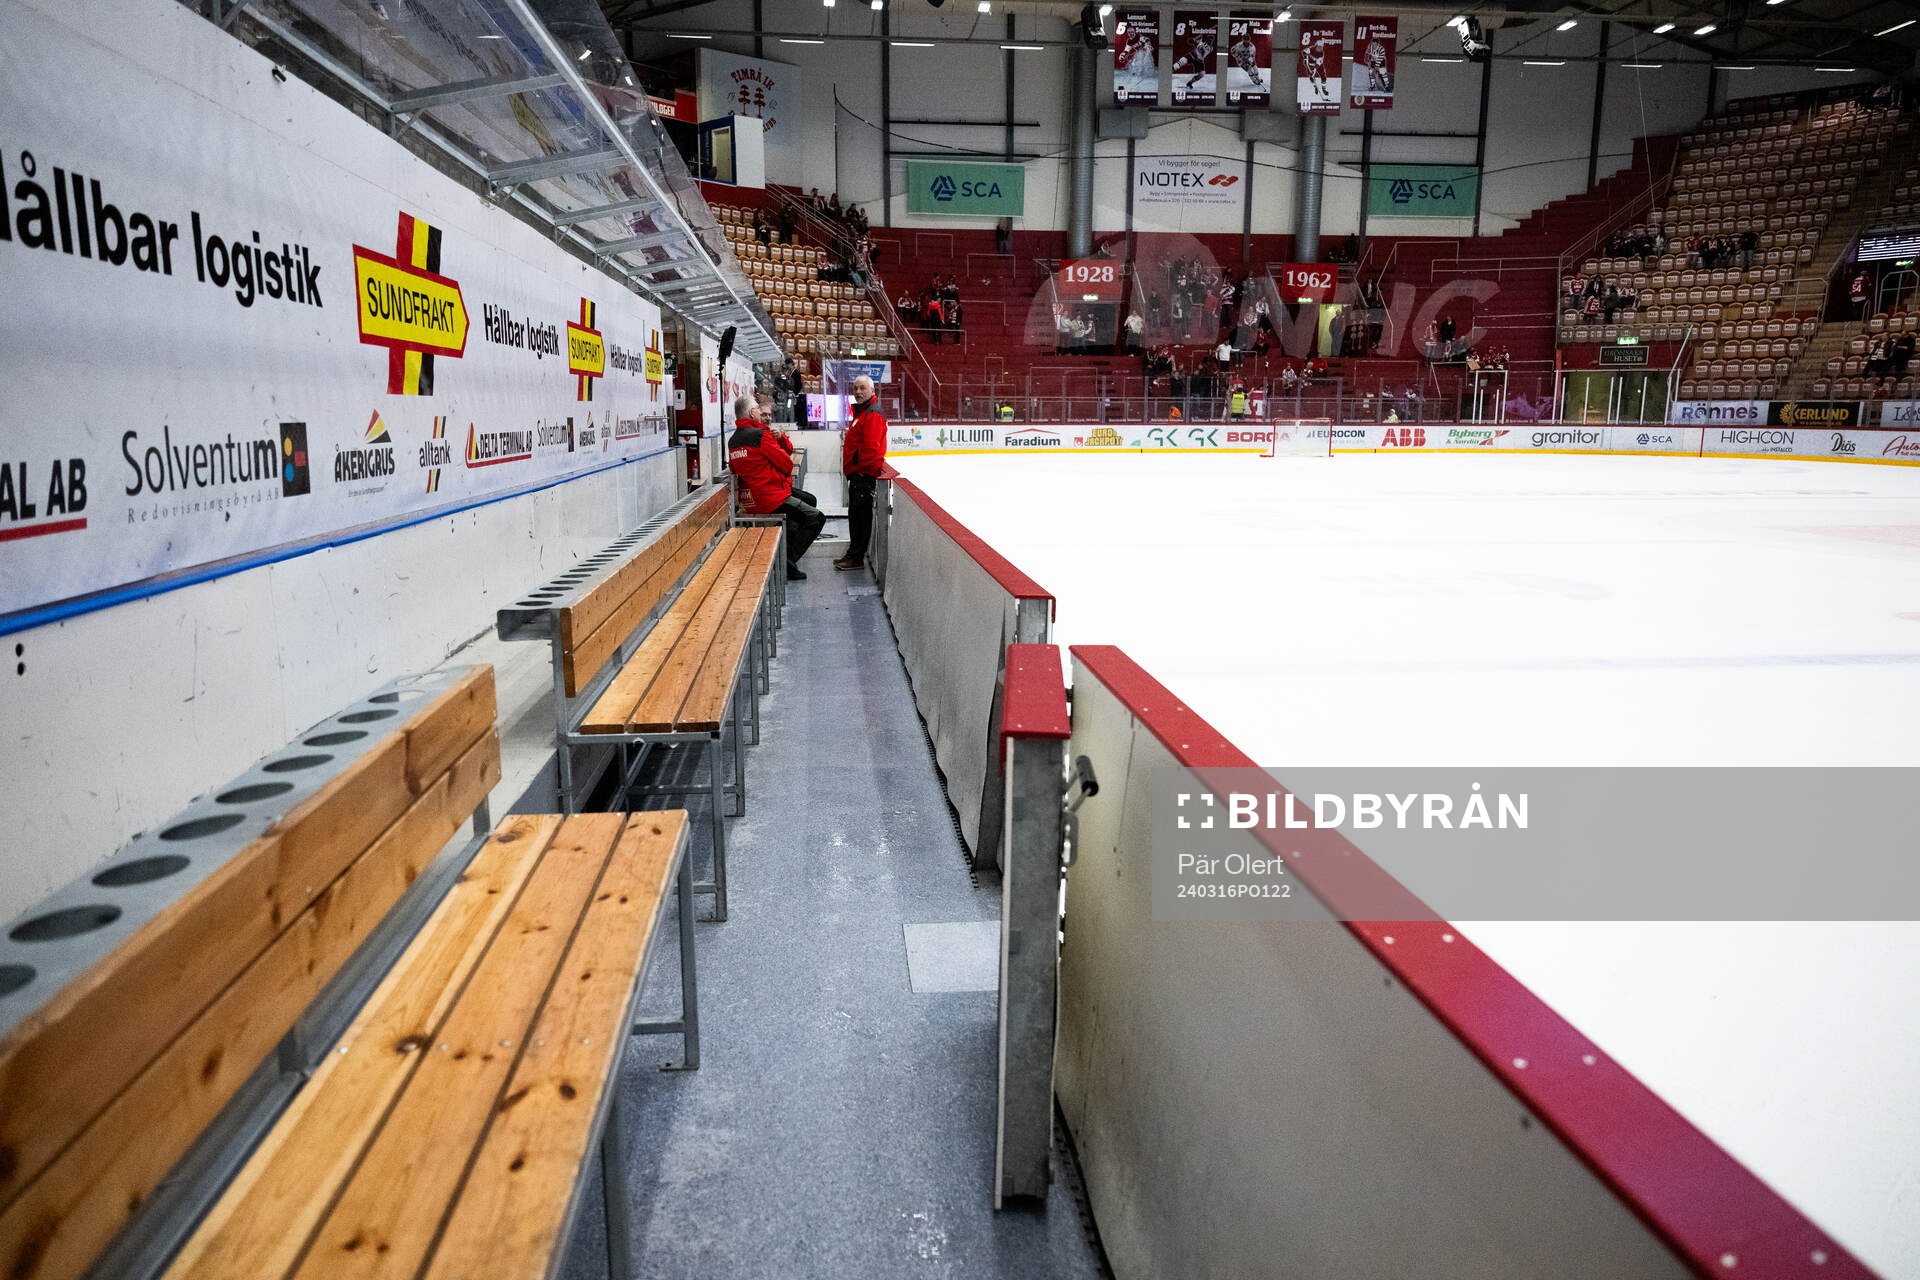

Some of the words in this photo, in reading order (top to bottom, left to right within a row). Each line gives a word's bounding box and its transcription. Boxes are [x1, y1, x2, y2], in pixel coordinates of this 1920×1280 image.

[1175, 22, 1186, 35] 8
[1230, 21, 1248, 36] 24
[1356, 27, 1368, 39] 11
[1301, 32, 1311, 45] 8
[731, 67, 762, 84] TIMRÅ
[1139, 171, 1205, 188] NOTEX
[961, 181, 1002, 199] SCA
[1418, 183, 1456, 200] SCA
[0, 148, 178, 276] ållbar
[191, 211, 323, 308] logistik
[1065, 265, 1115, 283] 1928
[1286, 270, 1332, 289] 1962
[367, 277, 455, 333] SUNDFRAKT
[483, 303, 525, 348] Hållbar
[526, 316, 560, 360] logistik
[571, 336, 601, 363] SUNDFRAKT
[1681, 402, 1759, 420] Rönnes
[537, 417, 568, 447] Solventum
[950, 429, 993, 443] LILIUM
[1381, 428, 1426, 447] ABB
[1448, 429, 1492, 439] Byberg
[1532, 429, 1600, 447] granitor
[1652, 435, 1673, 444] SCA
[1721, 430, 1795, 446] HIGHCON
[480, 433, 499, 459] DELTA
[1005, 436, 1061, 447] Faradium
[1831, 432, 1856, 453] Diös
[122, 425, 278, 497] Solventum
[419, 440, 452, 468] alltank
[46, 458, 88, 516] AB
